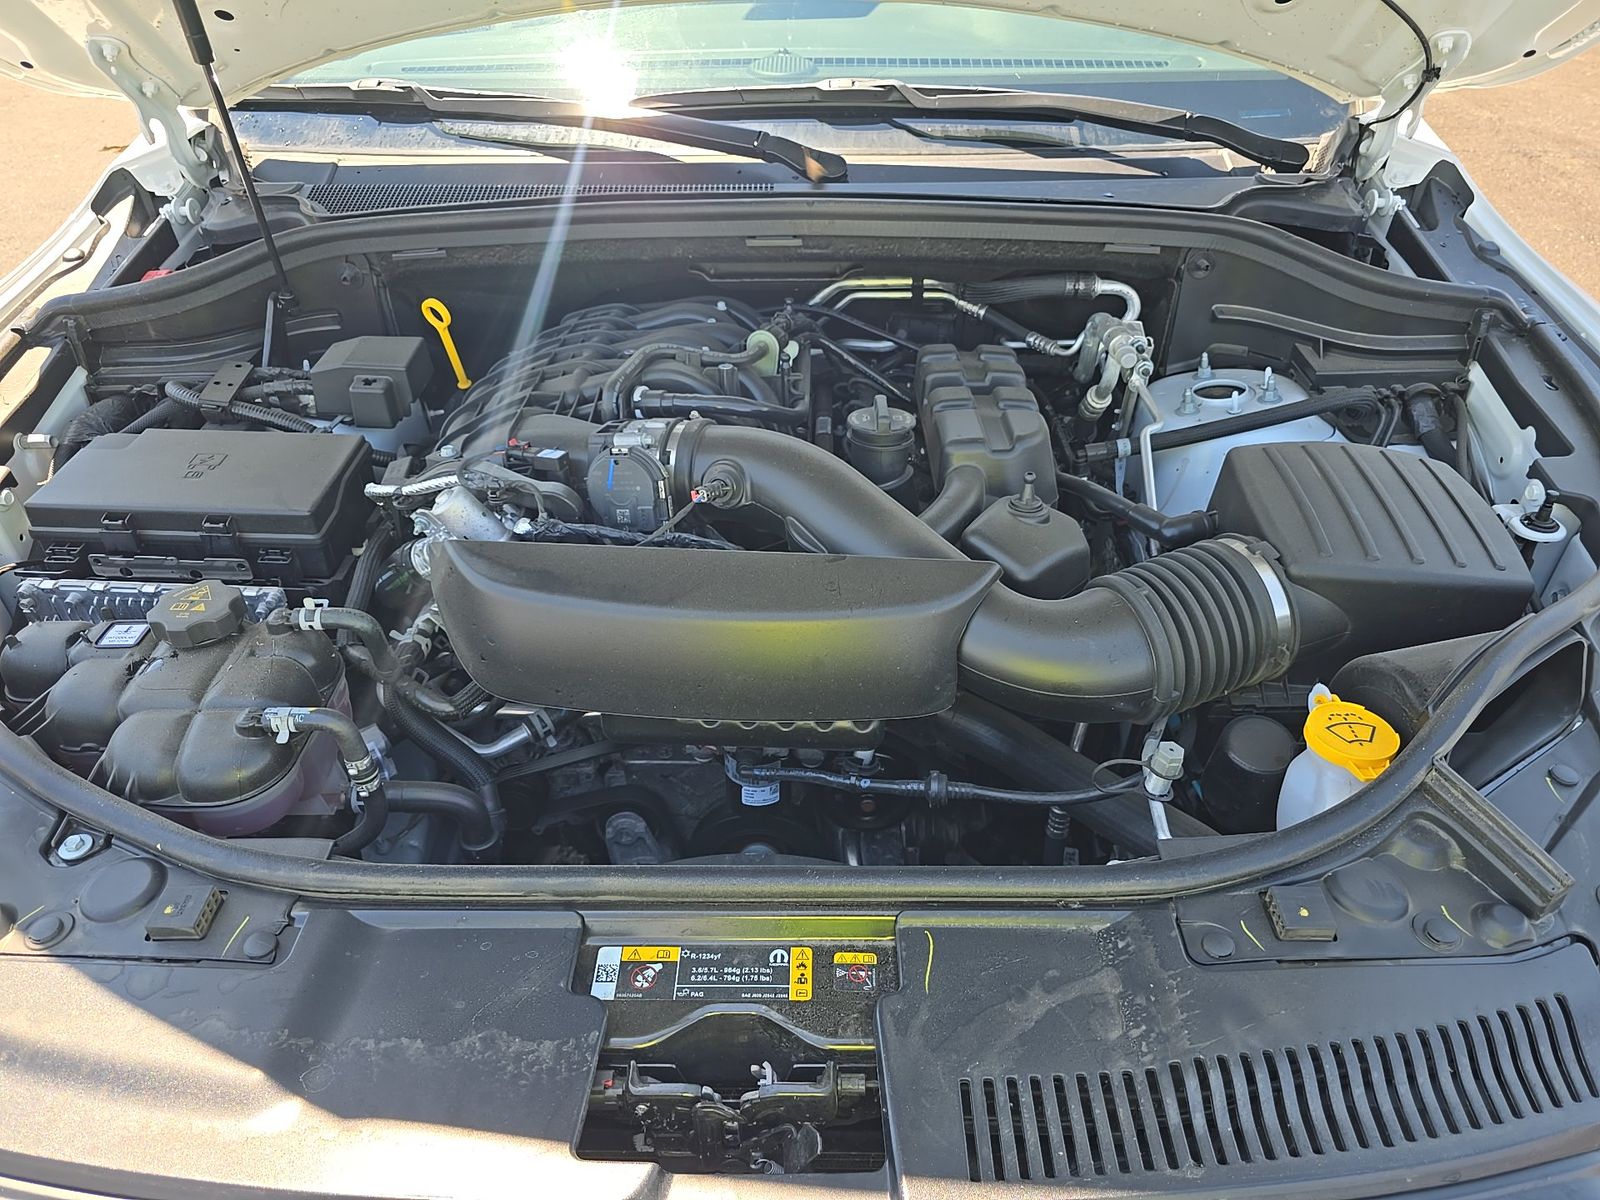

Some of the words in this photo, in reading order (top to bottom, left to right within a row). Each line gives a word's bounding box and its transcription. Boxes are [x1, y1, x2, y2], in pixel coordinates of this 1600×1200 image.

[742, 967, 759, 975] (2.13
[760, 967, 773, 975] lbs)
[723, 975, 741, 983] 794g
[759, 975, 773, 983] lbs)
